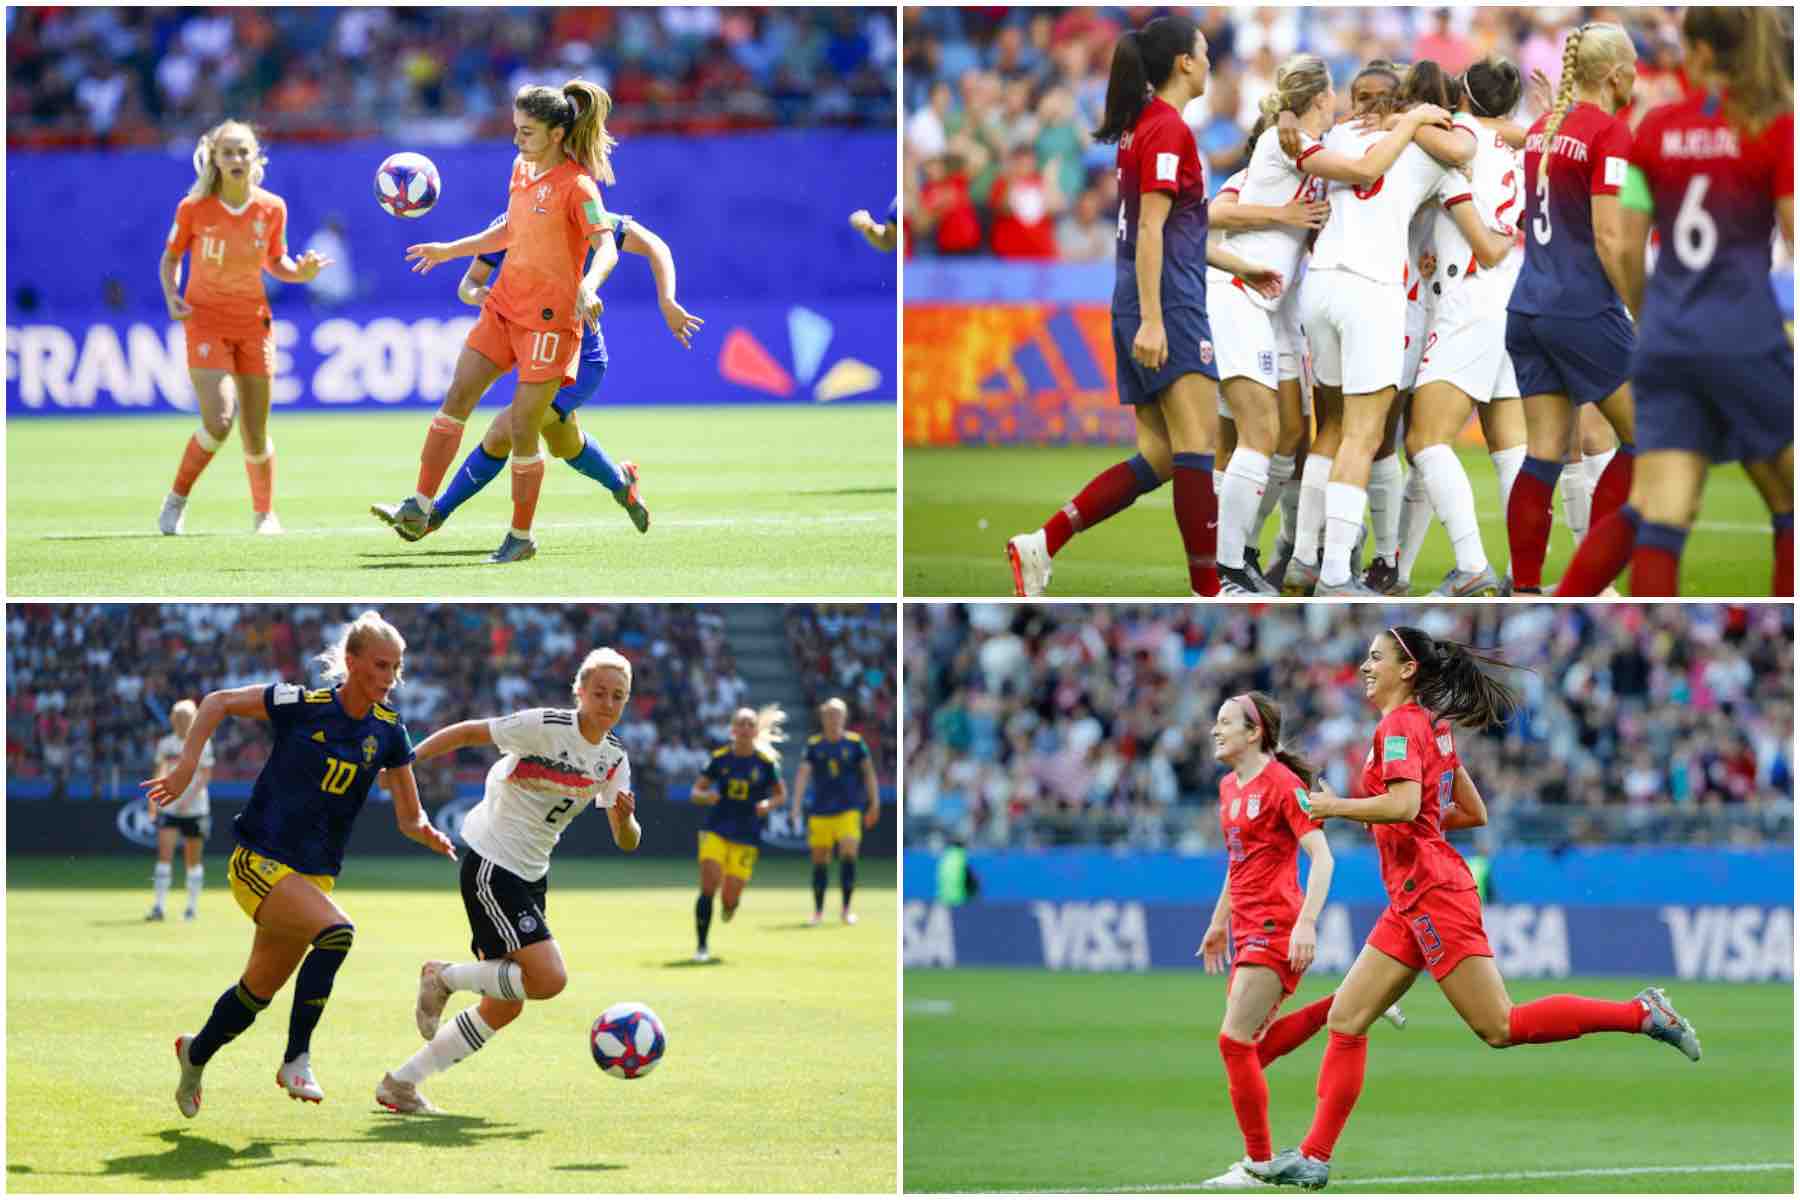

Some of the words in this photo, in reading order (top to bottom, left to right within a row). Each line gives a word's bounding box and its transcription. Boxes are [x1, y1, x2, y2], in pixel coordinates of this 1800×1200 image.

[1533, 175, 1552, 246] 3
[1673, 174, 1718, 271] 6
[202, 234, 225, 265] 14
[6, 322, 300, 414] RANE
[530, 331, 559, 362] 10
[320, 756, 358, 795] 10
[544, 799, 574, 824] 2
[1030, 898, 1150, 971] VISA
[1660, 904, 1795, 983] VISA
